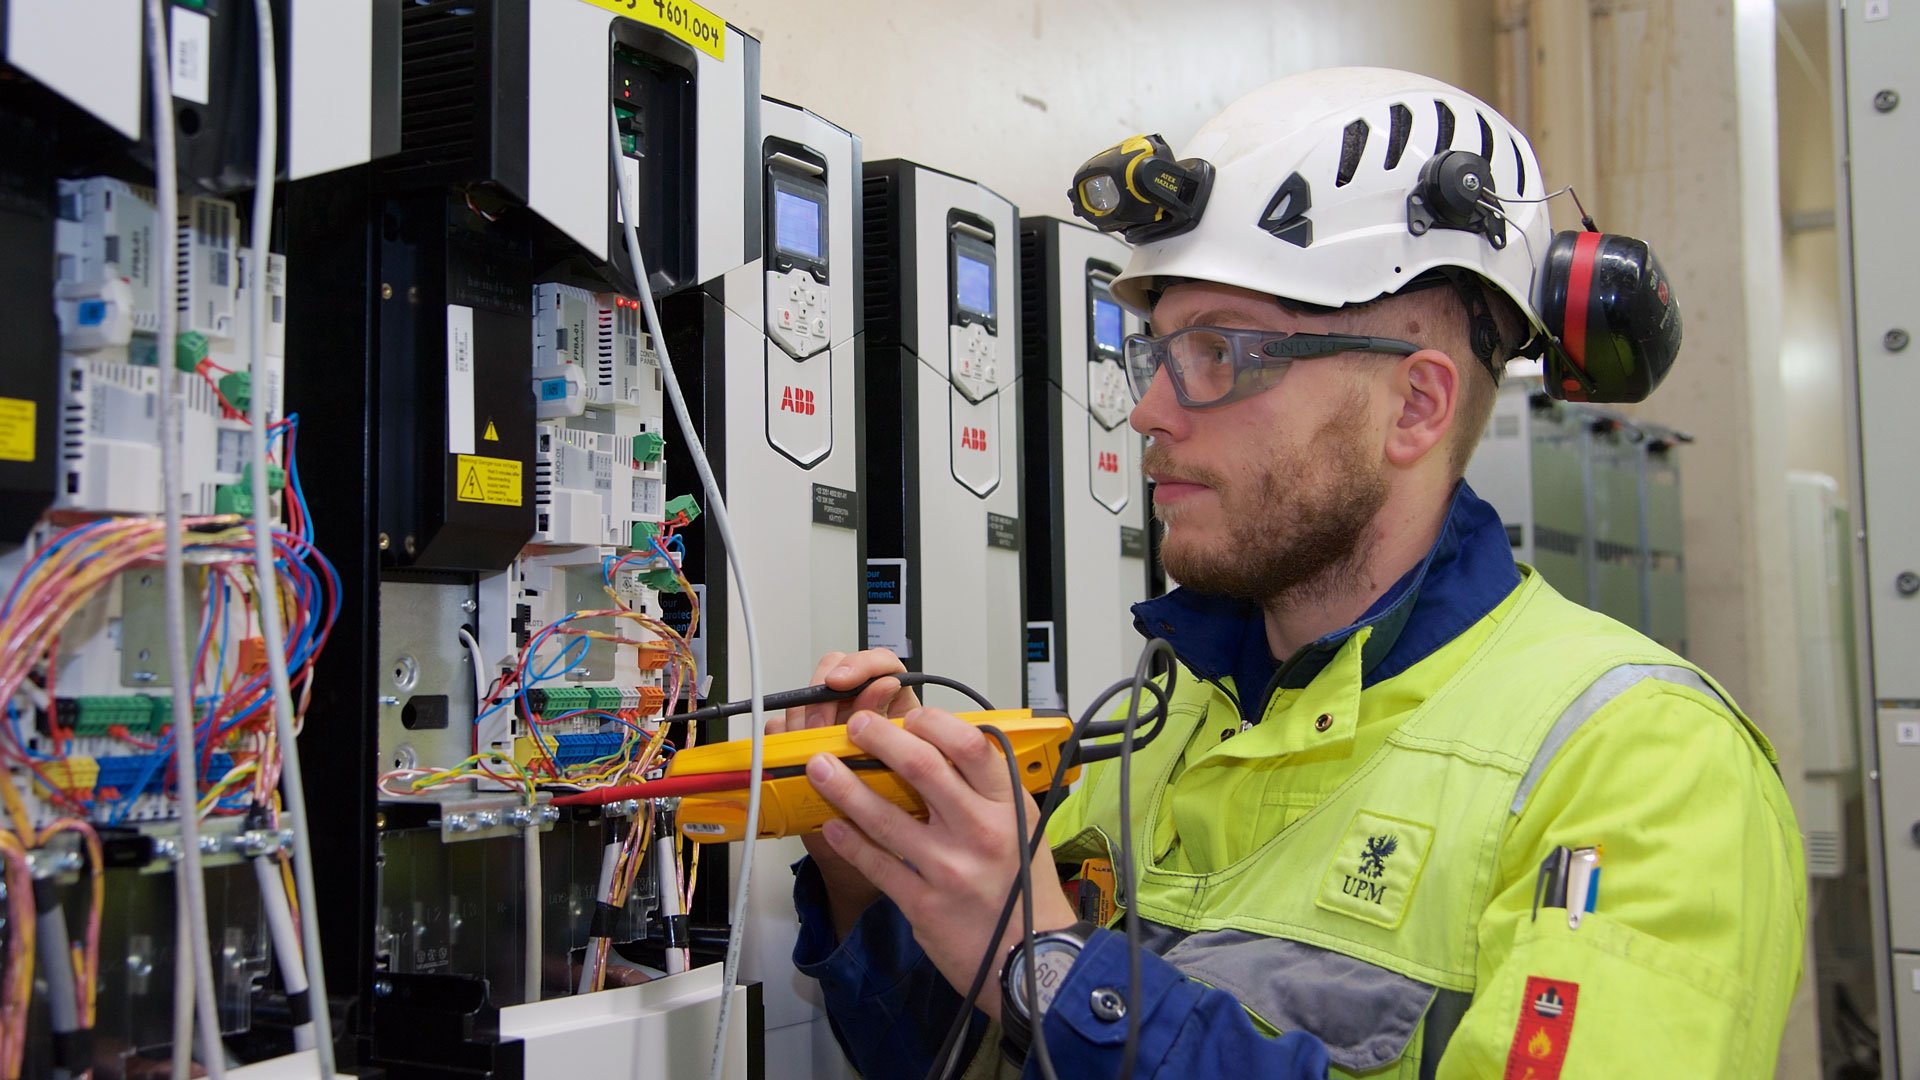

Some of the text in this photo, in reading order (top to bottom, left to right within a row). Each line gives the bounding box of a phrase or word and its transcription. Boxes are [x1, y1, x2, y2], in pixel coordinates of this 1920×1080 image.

[1154, 177, 1178, 192] HAZLOC
[1160, 172, 1176, 184] ATEX
[640, 357, 658, 367] PANEL
[781, 385, 815, 416] ABB
[961, 426, 987, 452] ABB
[1097, 451, 1118, 473] ABB
[1343, 875, 1388, 904] UPM
